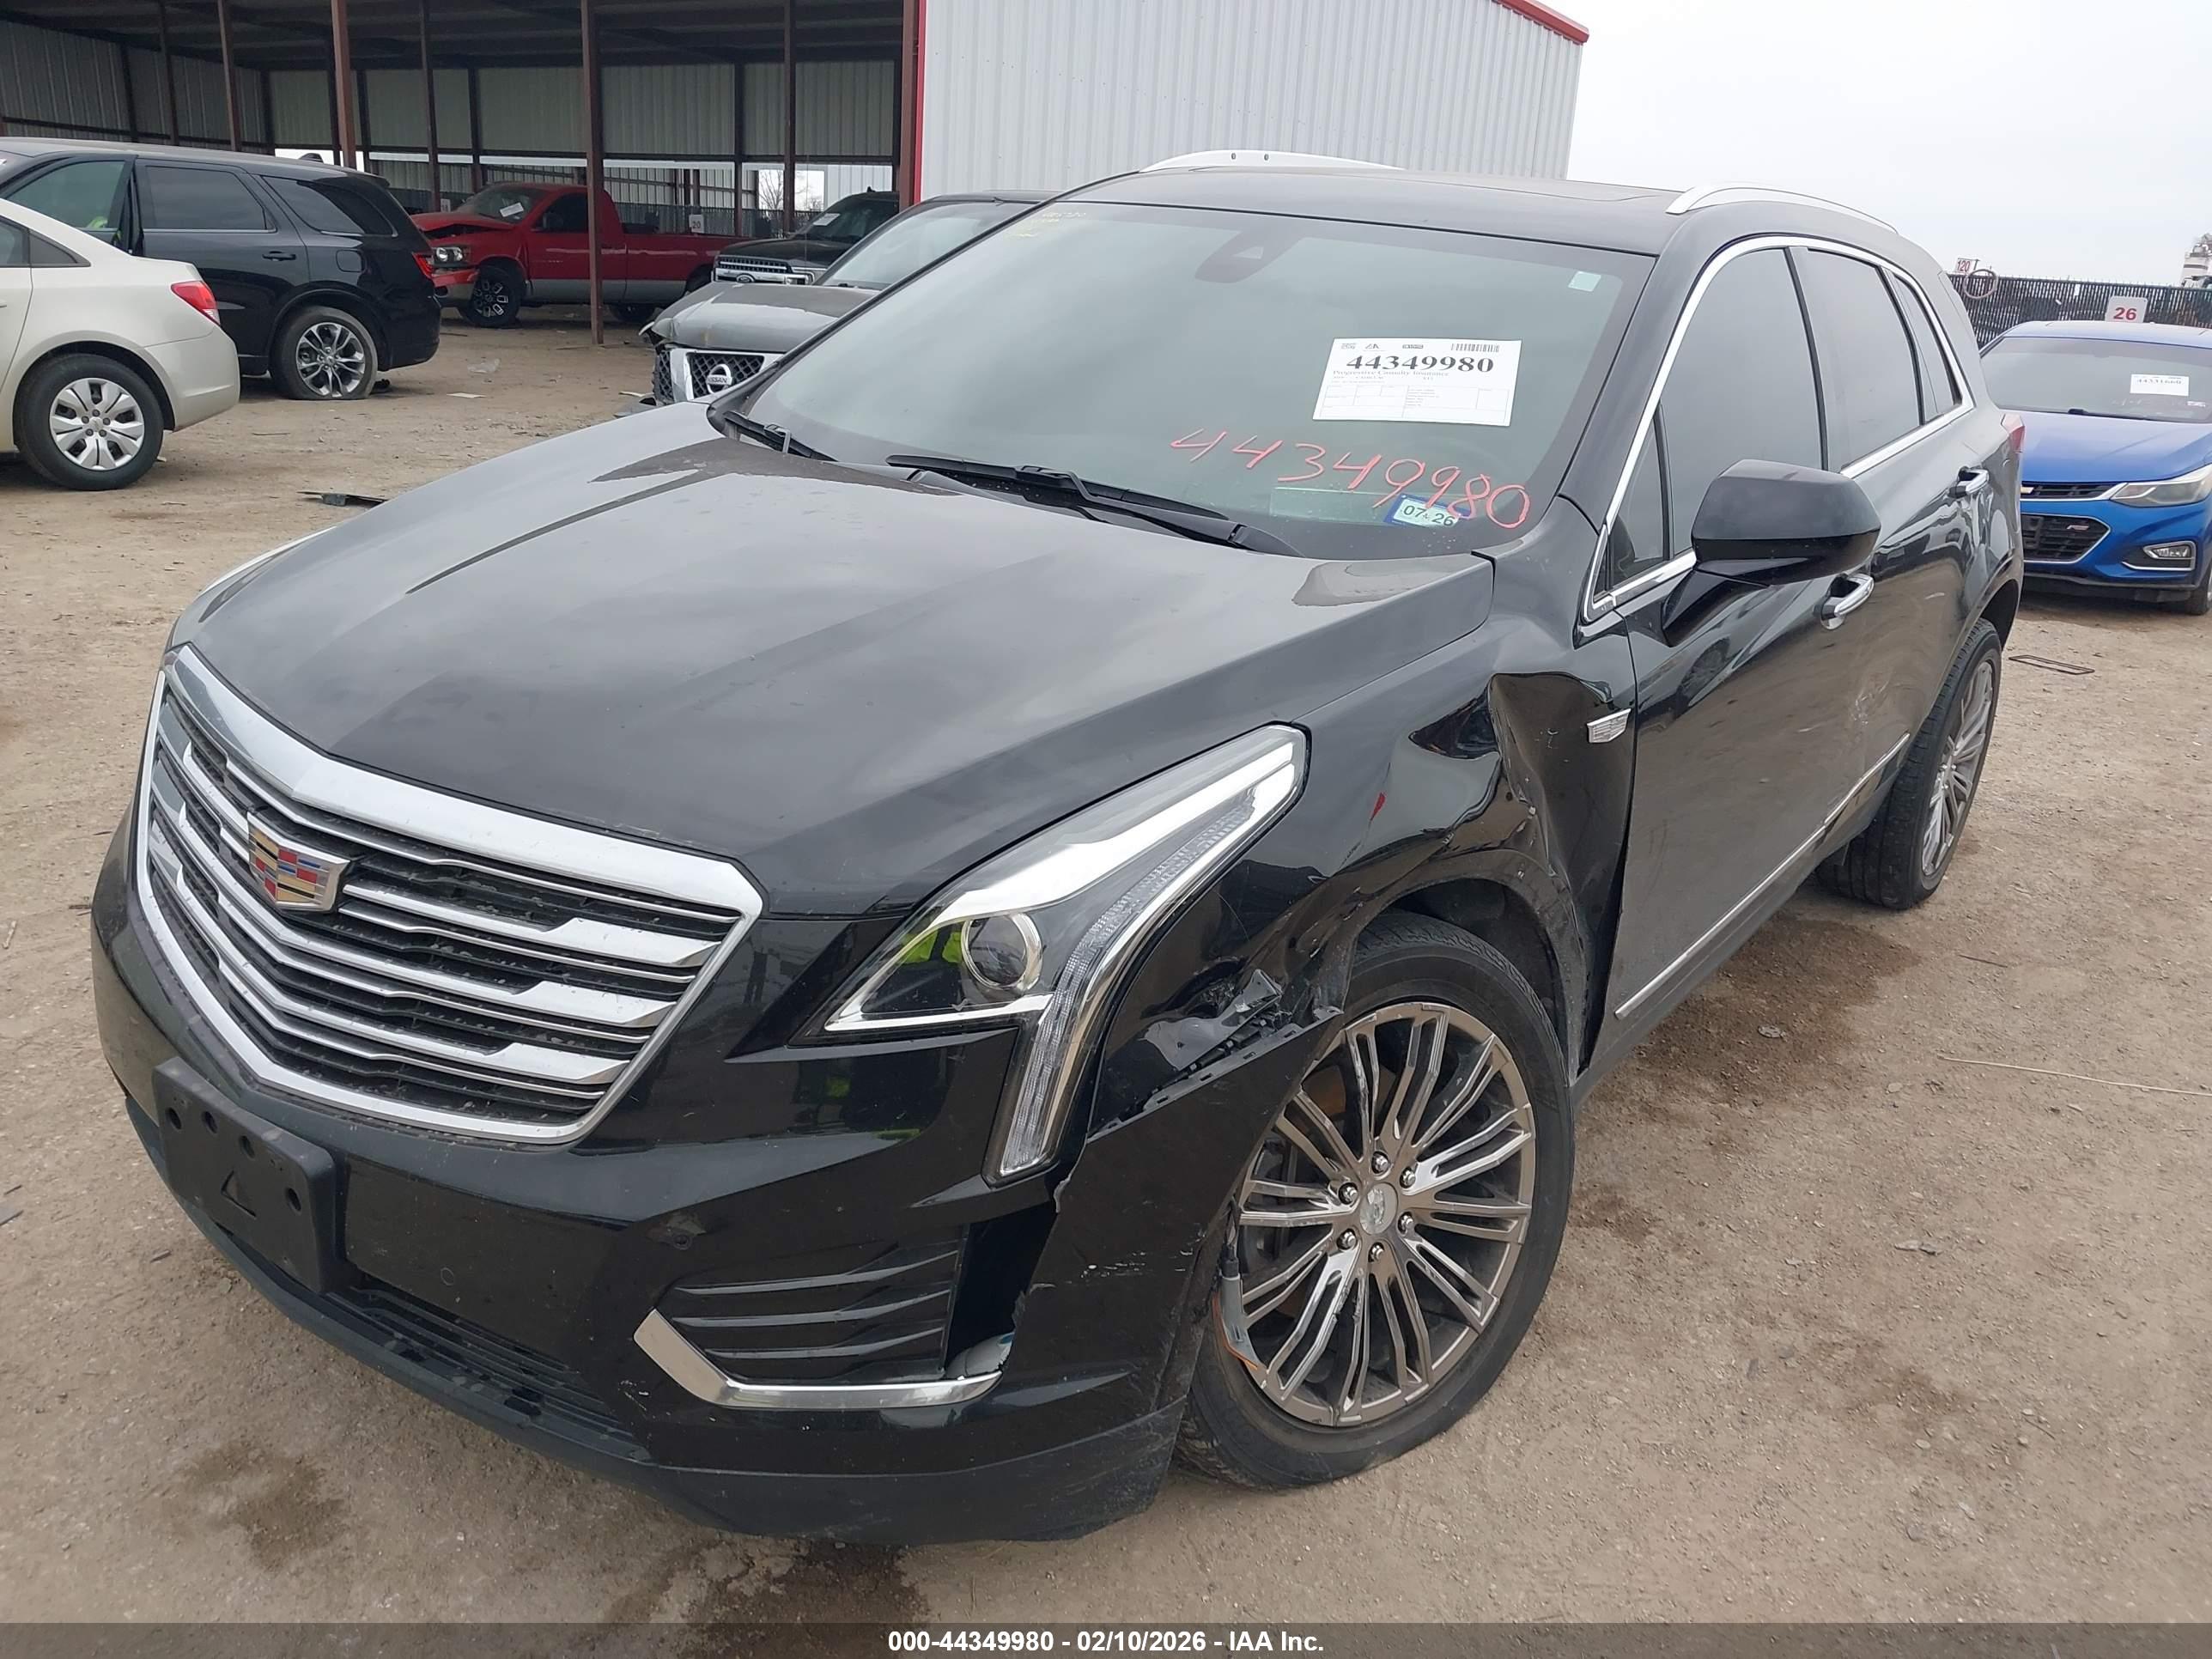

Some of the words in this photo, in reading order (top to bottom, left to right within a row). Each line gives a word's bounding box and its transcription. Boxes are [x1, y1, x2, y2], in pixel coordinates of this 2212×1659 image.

[1957, 259, 1971, 272] 120
[2113, 307, 2137, 320] 26
[1346, 355, 1494, 373] 44349980
[1170, 428, 1531, 529] 44349980
[1403, 505, 1426, 518] 07
[1431, 513, 1455, 526] 26
